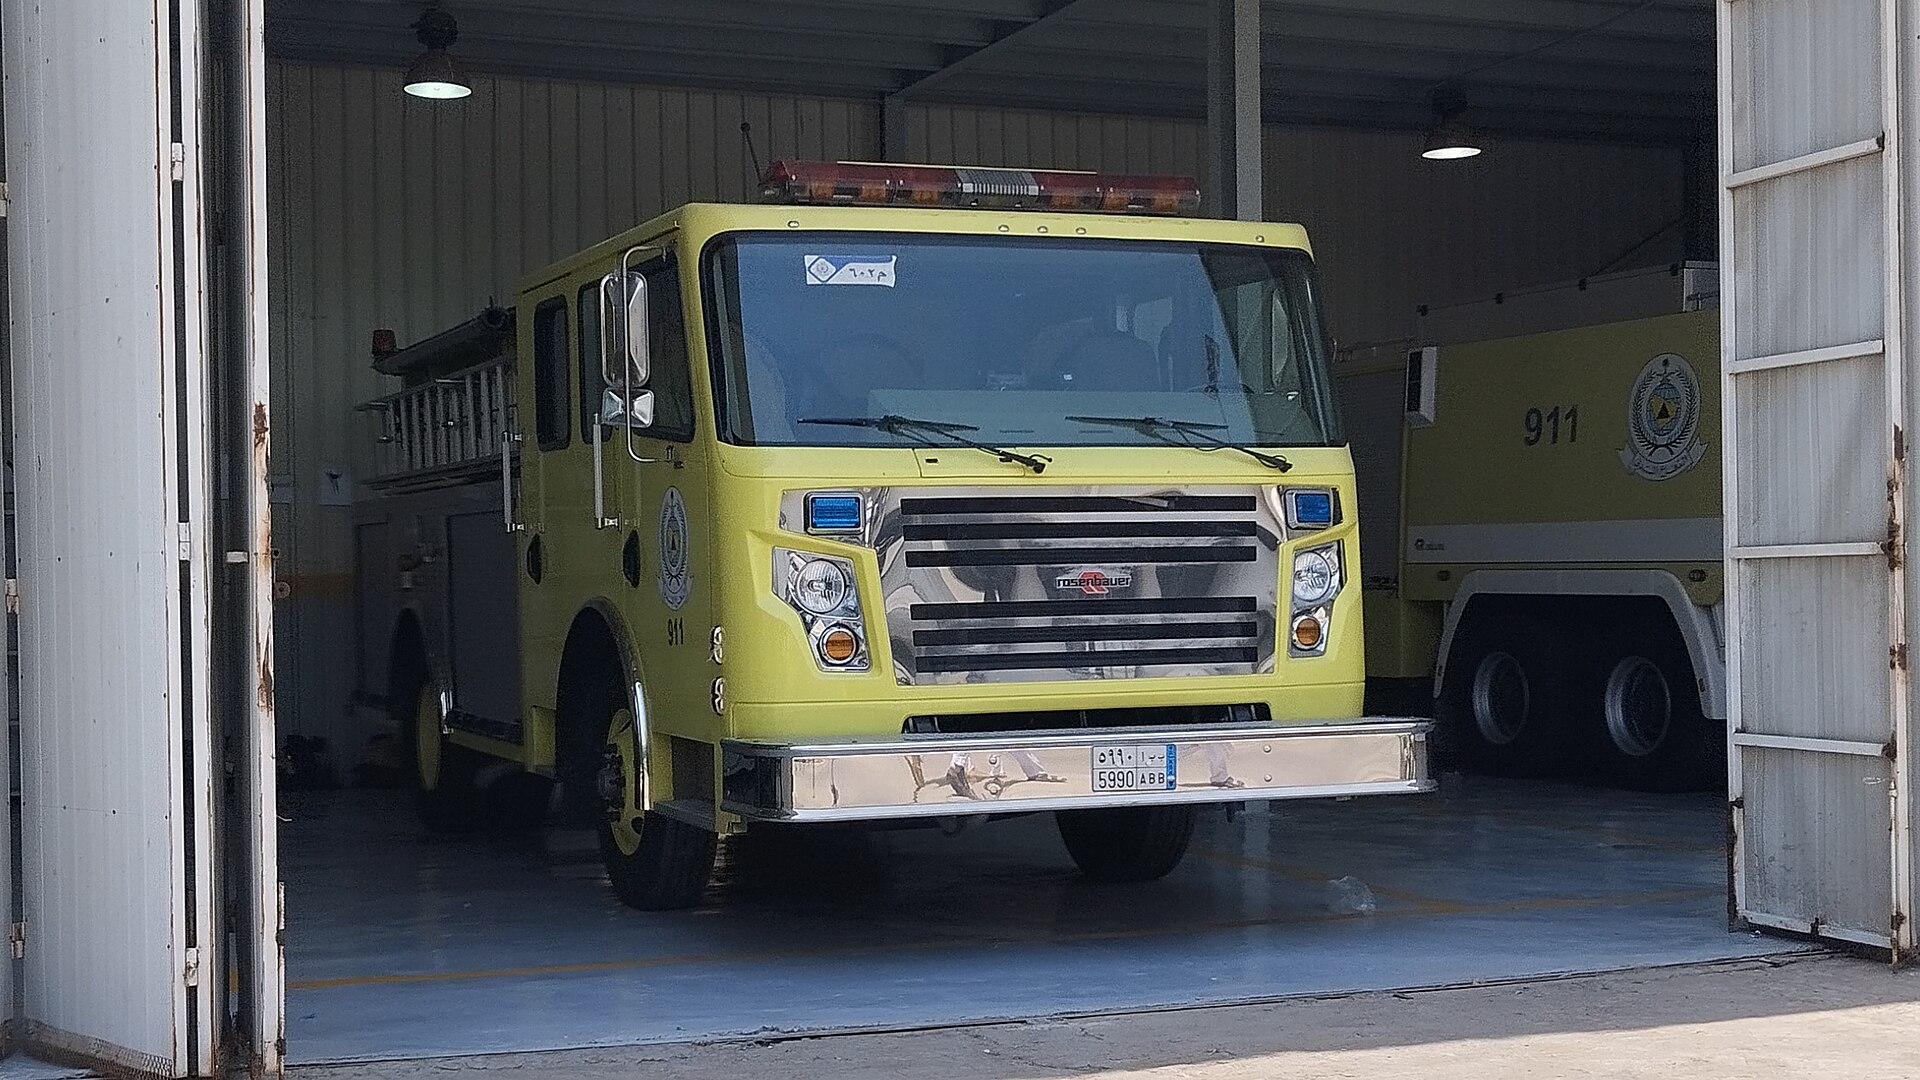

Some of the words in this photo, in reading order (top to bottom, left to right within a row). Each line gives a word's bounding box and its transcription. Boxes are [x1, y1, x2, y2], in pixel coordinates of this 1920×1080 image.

[1523, 405, 1579, 446] 911
[1056, 574, 1132, 588] rosenbauer
[667, 616, 684, 646] 911
[1098, 748, 1133, 765] ٥٩٩٠
[1098, 770, 1134, 789] 5990
[1140, 772, 1165, 785] ABB
